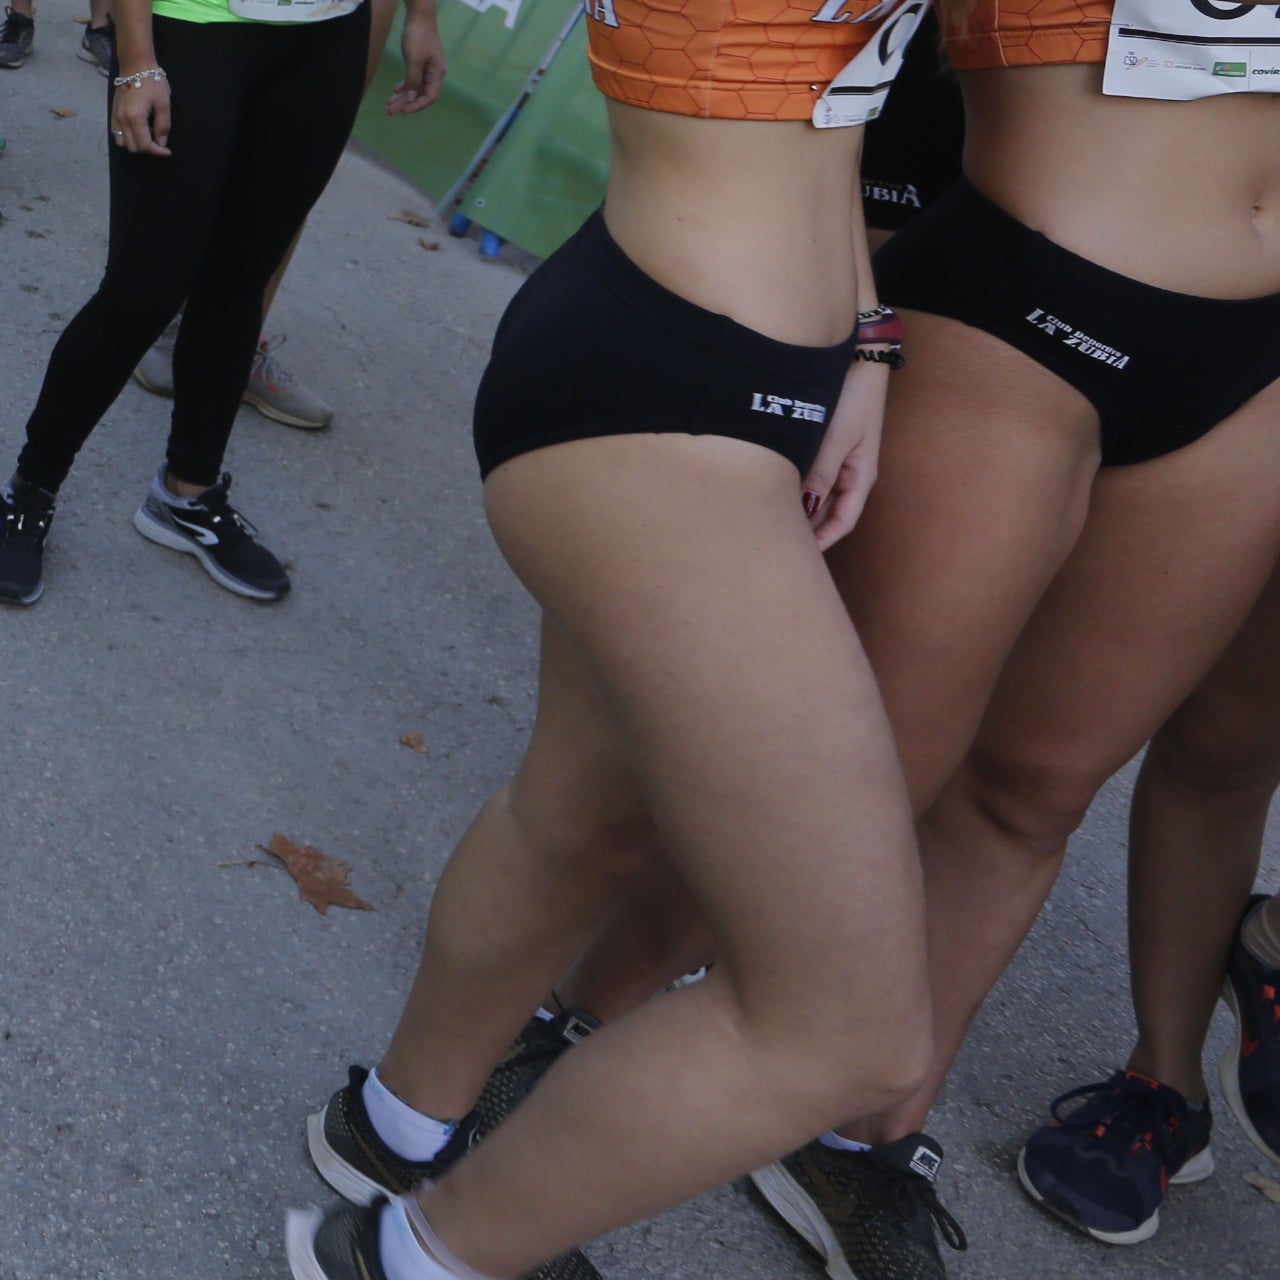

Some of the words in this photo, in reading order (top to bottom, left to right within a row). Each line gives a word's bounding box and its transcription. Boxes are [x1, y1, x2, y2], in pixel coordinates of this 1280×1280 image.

[1025, 308, 1056, 336] LA
[1073, 330, 1122, 358] Deportivo
[750, 393, 784, 416] LA
